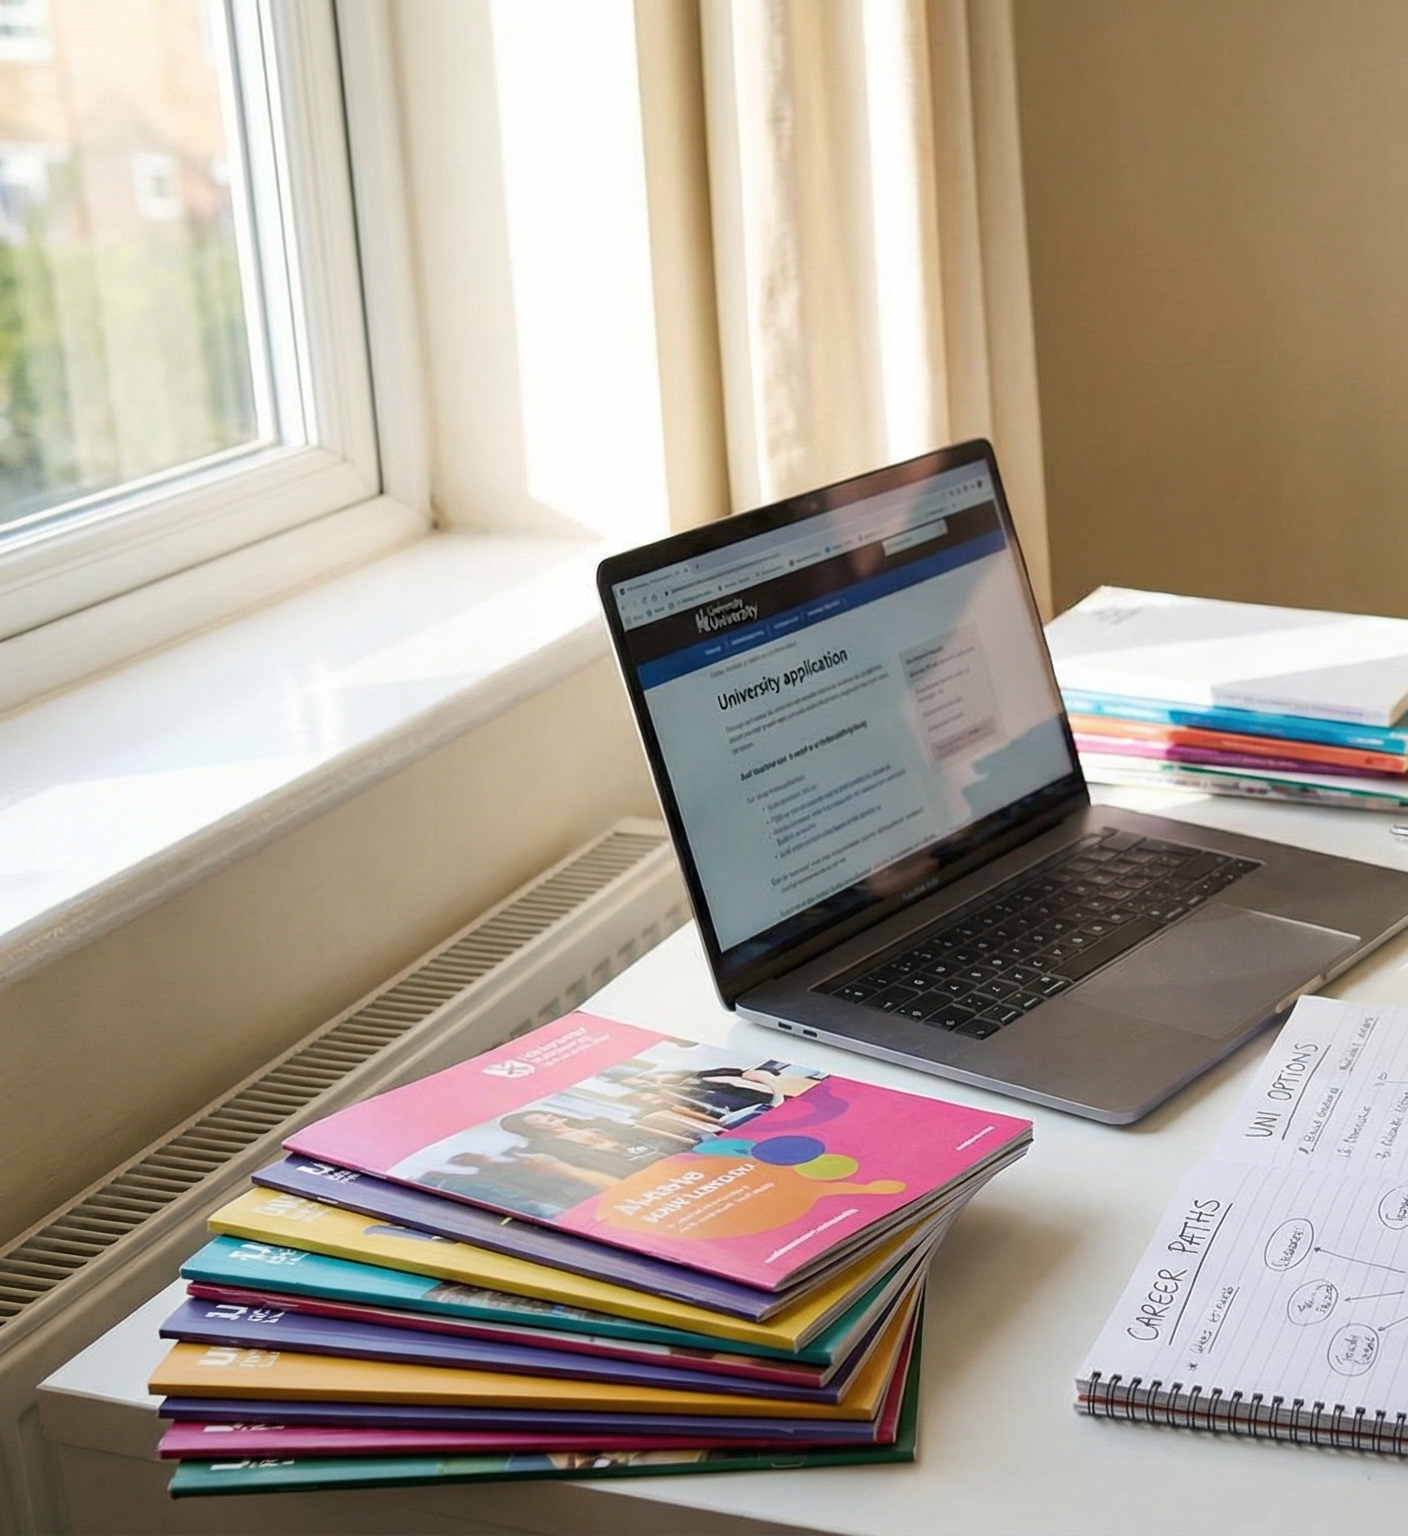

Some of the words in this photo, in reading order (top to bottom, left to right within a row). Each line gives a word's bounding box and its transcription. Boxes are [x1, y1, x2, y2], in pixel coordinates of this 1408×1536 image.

[717, 676, 780, 710] University
[784, 649, 848, 686] application
[1245, 1110, 1280, 1140] UNI
[1126, 1268, 1188, 1342] CAREER
[1168, 1199, 1221, 1255] PATHS
